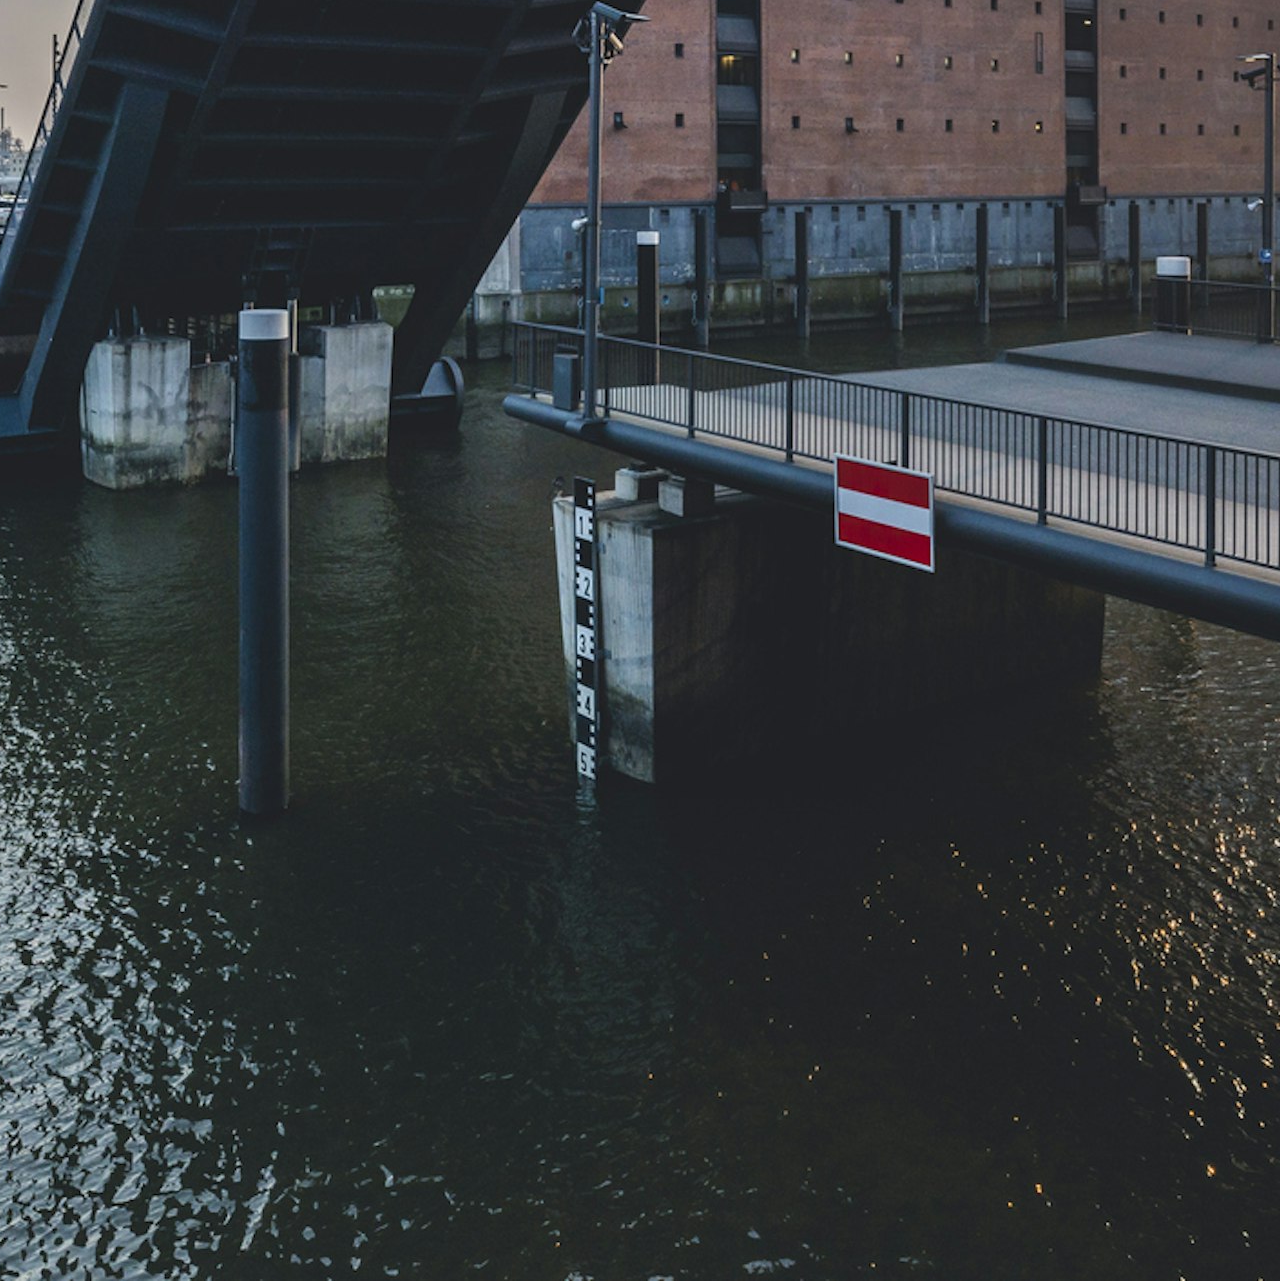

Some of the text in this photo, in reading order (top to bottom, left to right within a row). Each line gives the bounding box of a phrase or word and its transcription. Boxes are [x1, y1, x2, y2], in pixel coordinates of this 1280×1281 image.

[578, 516, 584, 535] 1
[583, 577, 591, 596] 2
[578, 633, 587, 654] 3
[584, 696, 592, 715] 4
[580, 750, 588, 772] 5
